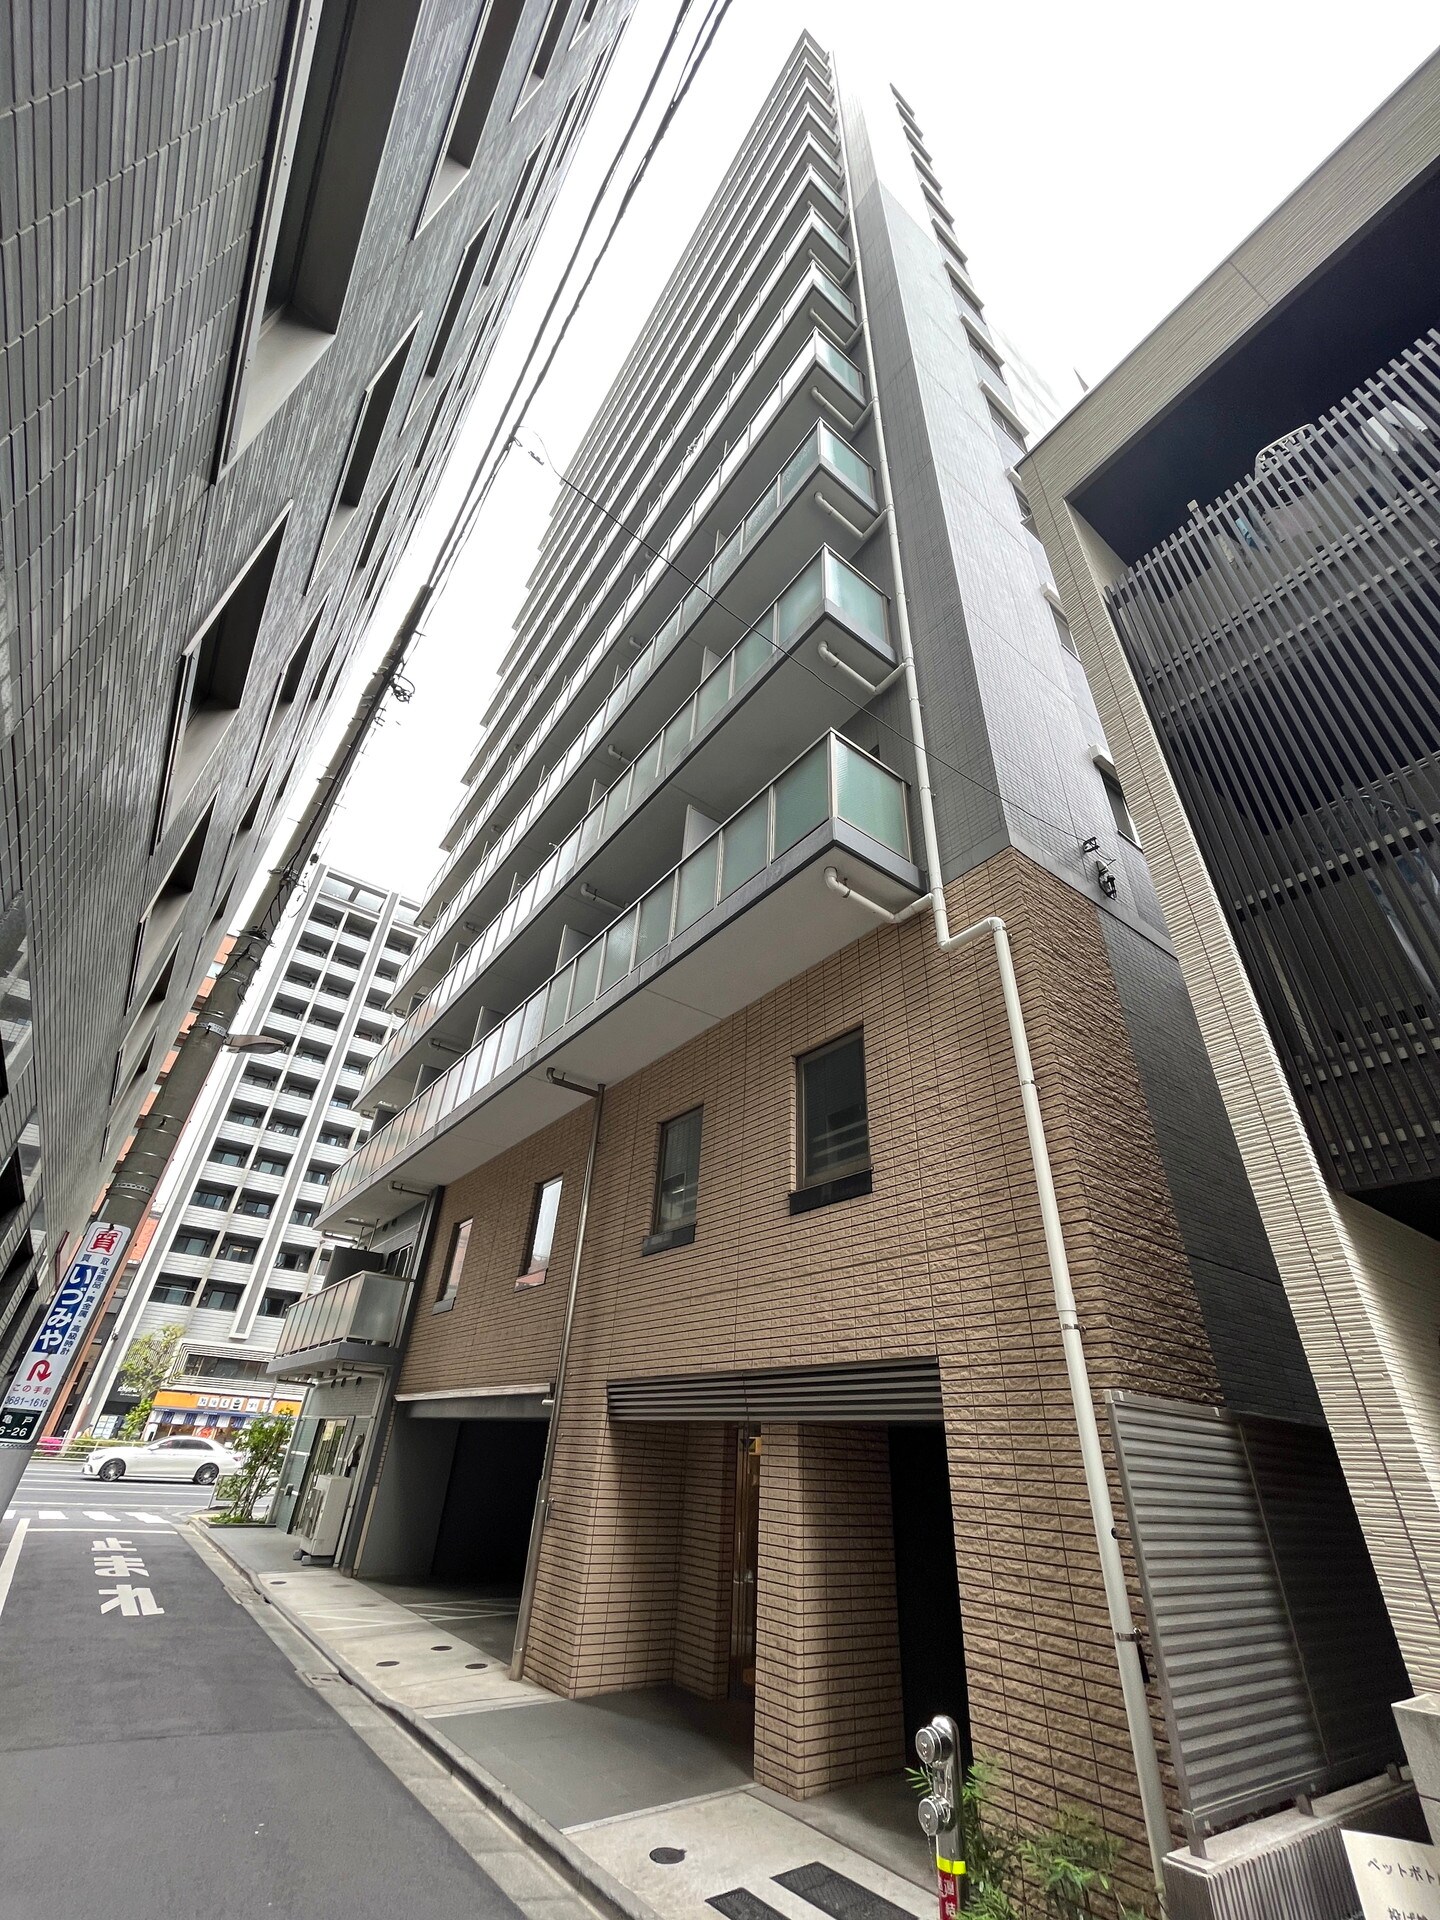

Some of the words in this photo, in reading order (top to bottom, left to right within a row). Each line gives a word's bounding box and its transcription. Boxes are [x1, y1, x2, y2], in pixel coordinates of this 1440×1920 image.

[91, 1231, 118, 1253] 質
[40, 1266, 92, 1350] いづみや
[13, 1384, 51, 1395] この手前
[2, 1414, 34, 1425] 亀戸
[91, 1538, 165, 1617] 止まれ
[1368, 1858, 1440, 1885] ペットボト
